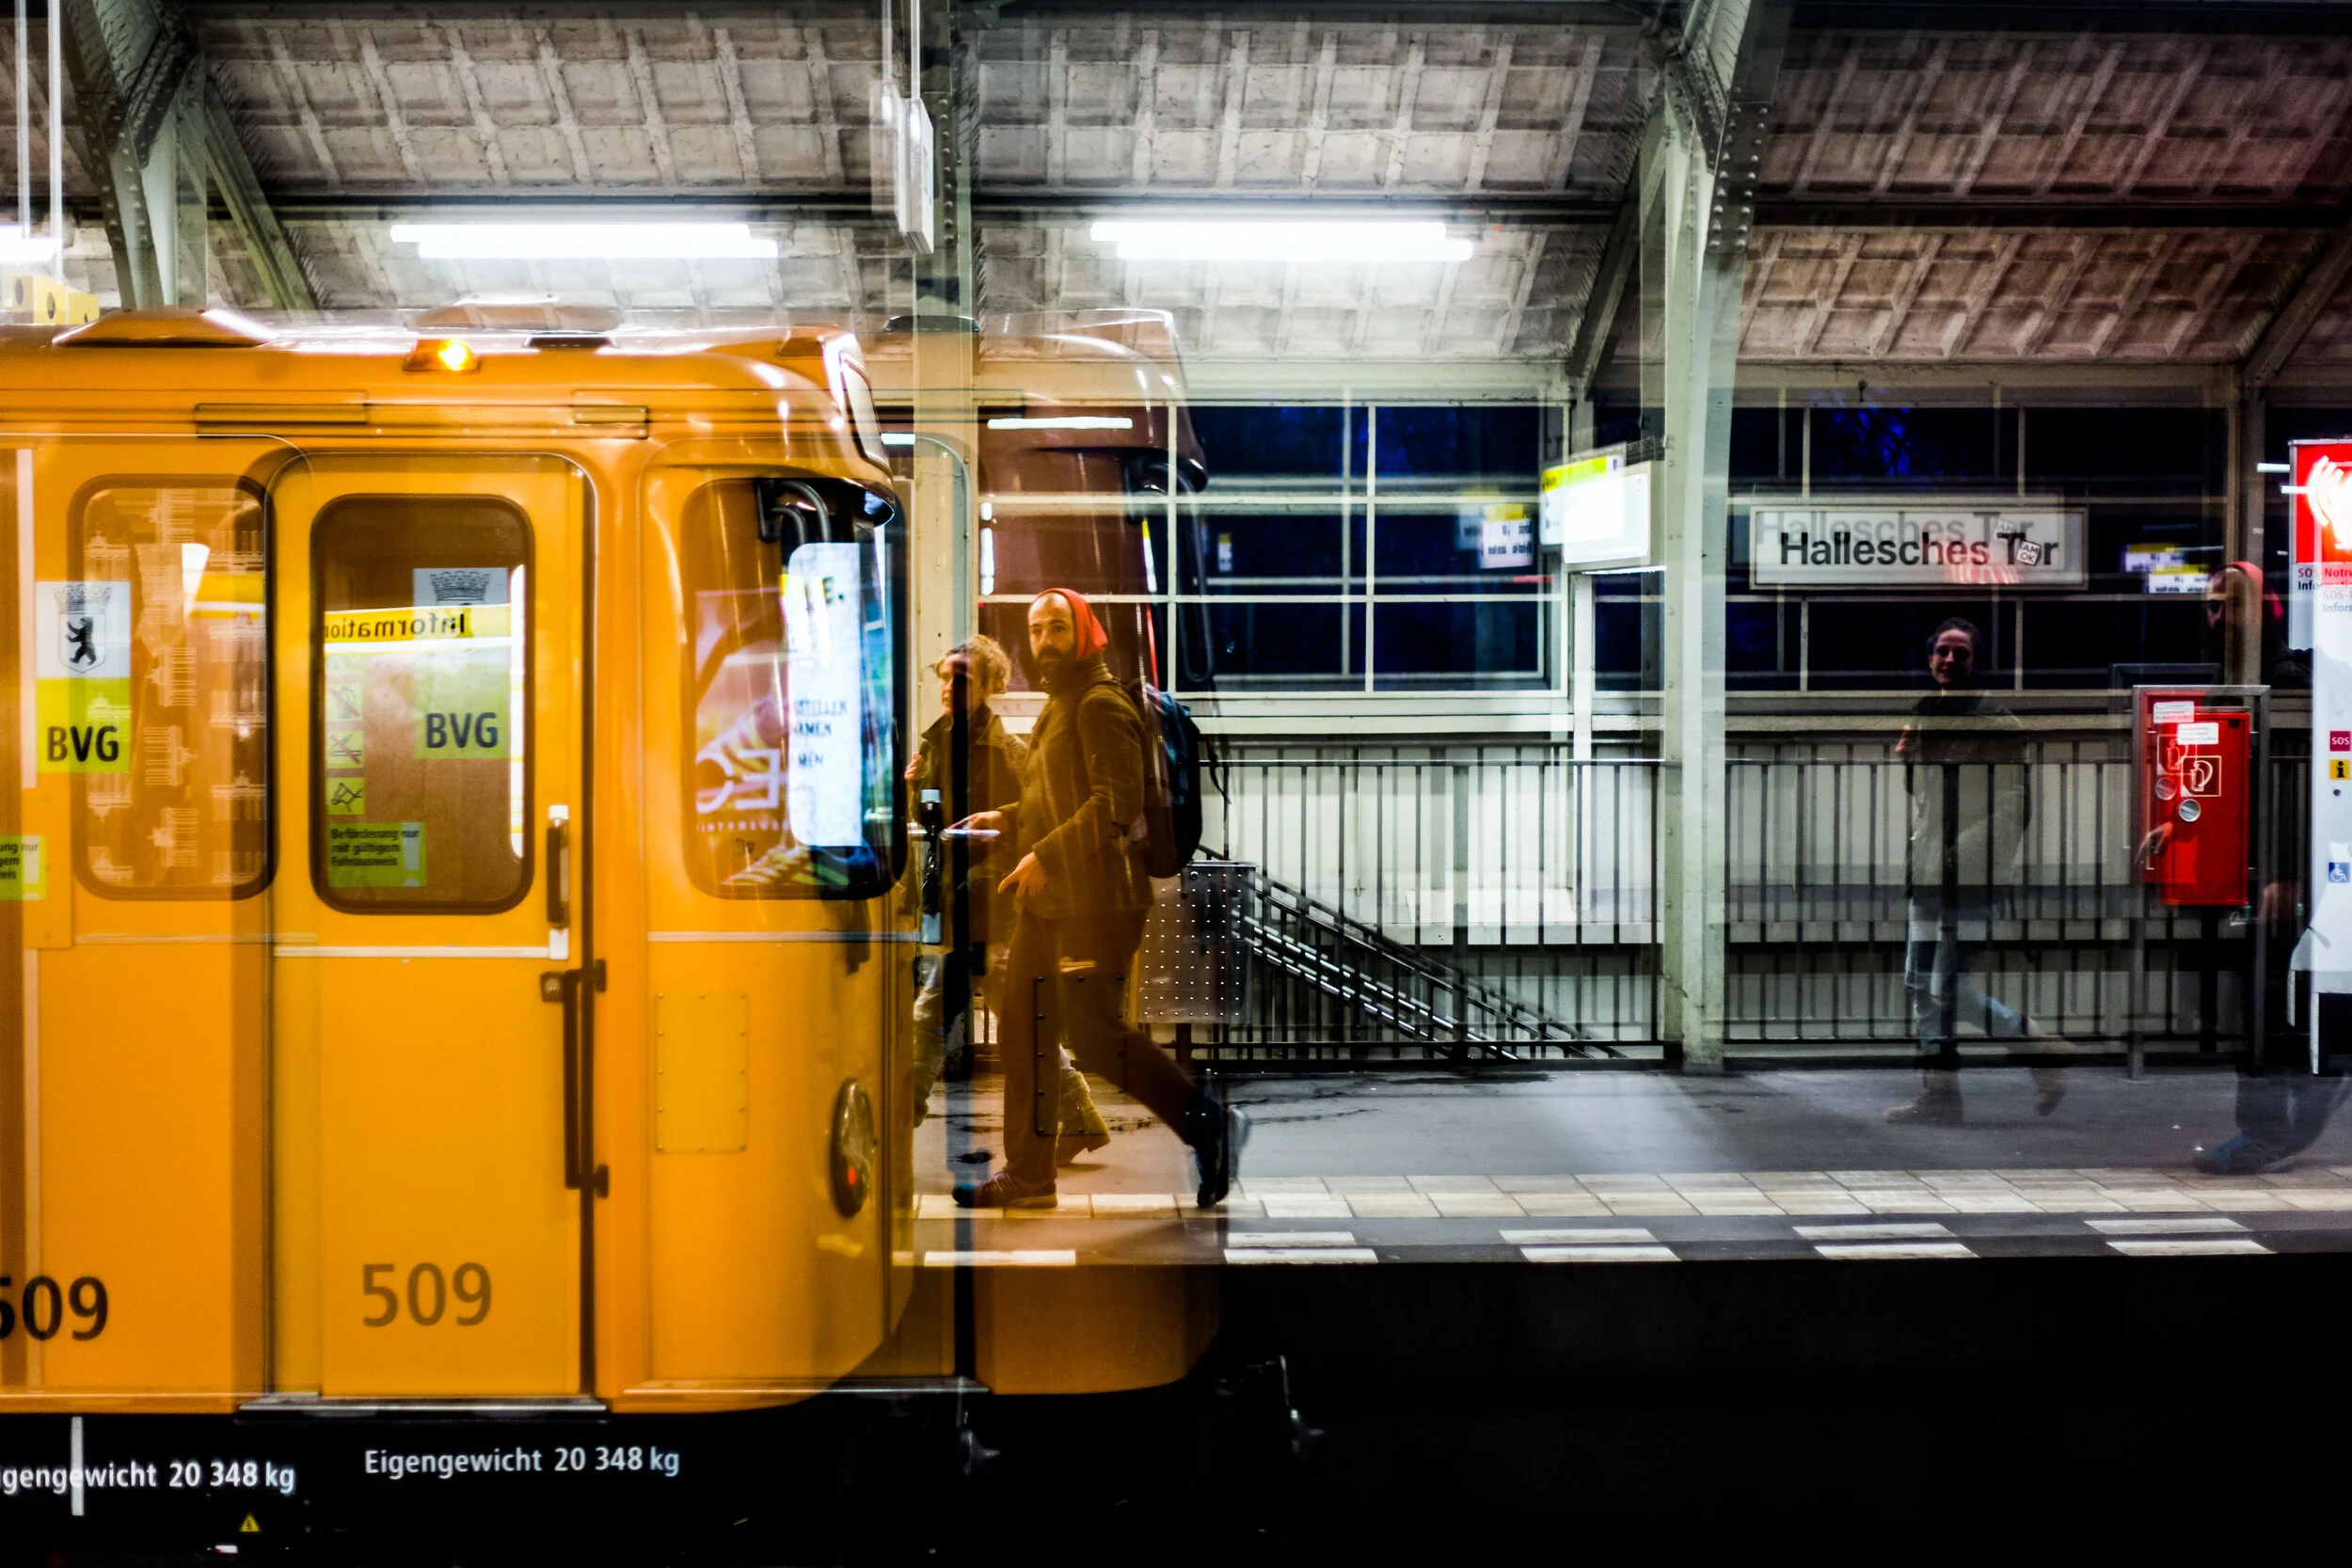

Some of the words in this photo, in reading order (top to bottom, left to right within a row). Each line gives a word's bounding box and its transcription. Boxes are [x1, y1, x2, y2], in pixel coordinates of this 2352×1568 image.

[1781, 532, 1989, 565] Hallesches
[1996, 532, 2058, 565] Tr
[47, 726, 119, 762] BVG
[426, 712, 498, 748] BVG
[2331, 736, 2350, 746] SOS
[362, 1261, 492, 1327] 509
[169, 1462, 201, 1487] 20
[210, 1462, 258, 1487] 348
[265, 1462, 295, 1494] kg
[365, 1448, 543, 1480] Eigengewicht
[554, 1448, 586, 1471] 20
[595, 1447, 644, 1471] 348
[650, 1447, 680, 1478] kg
